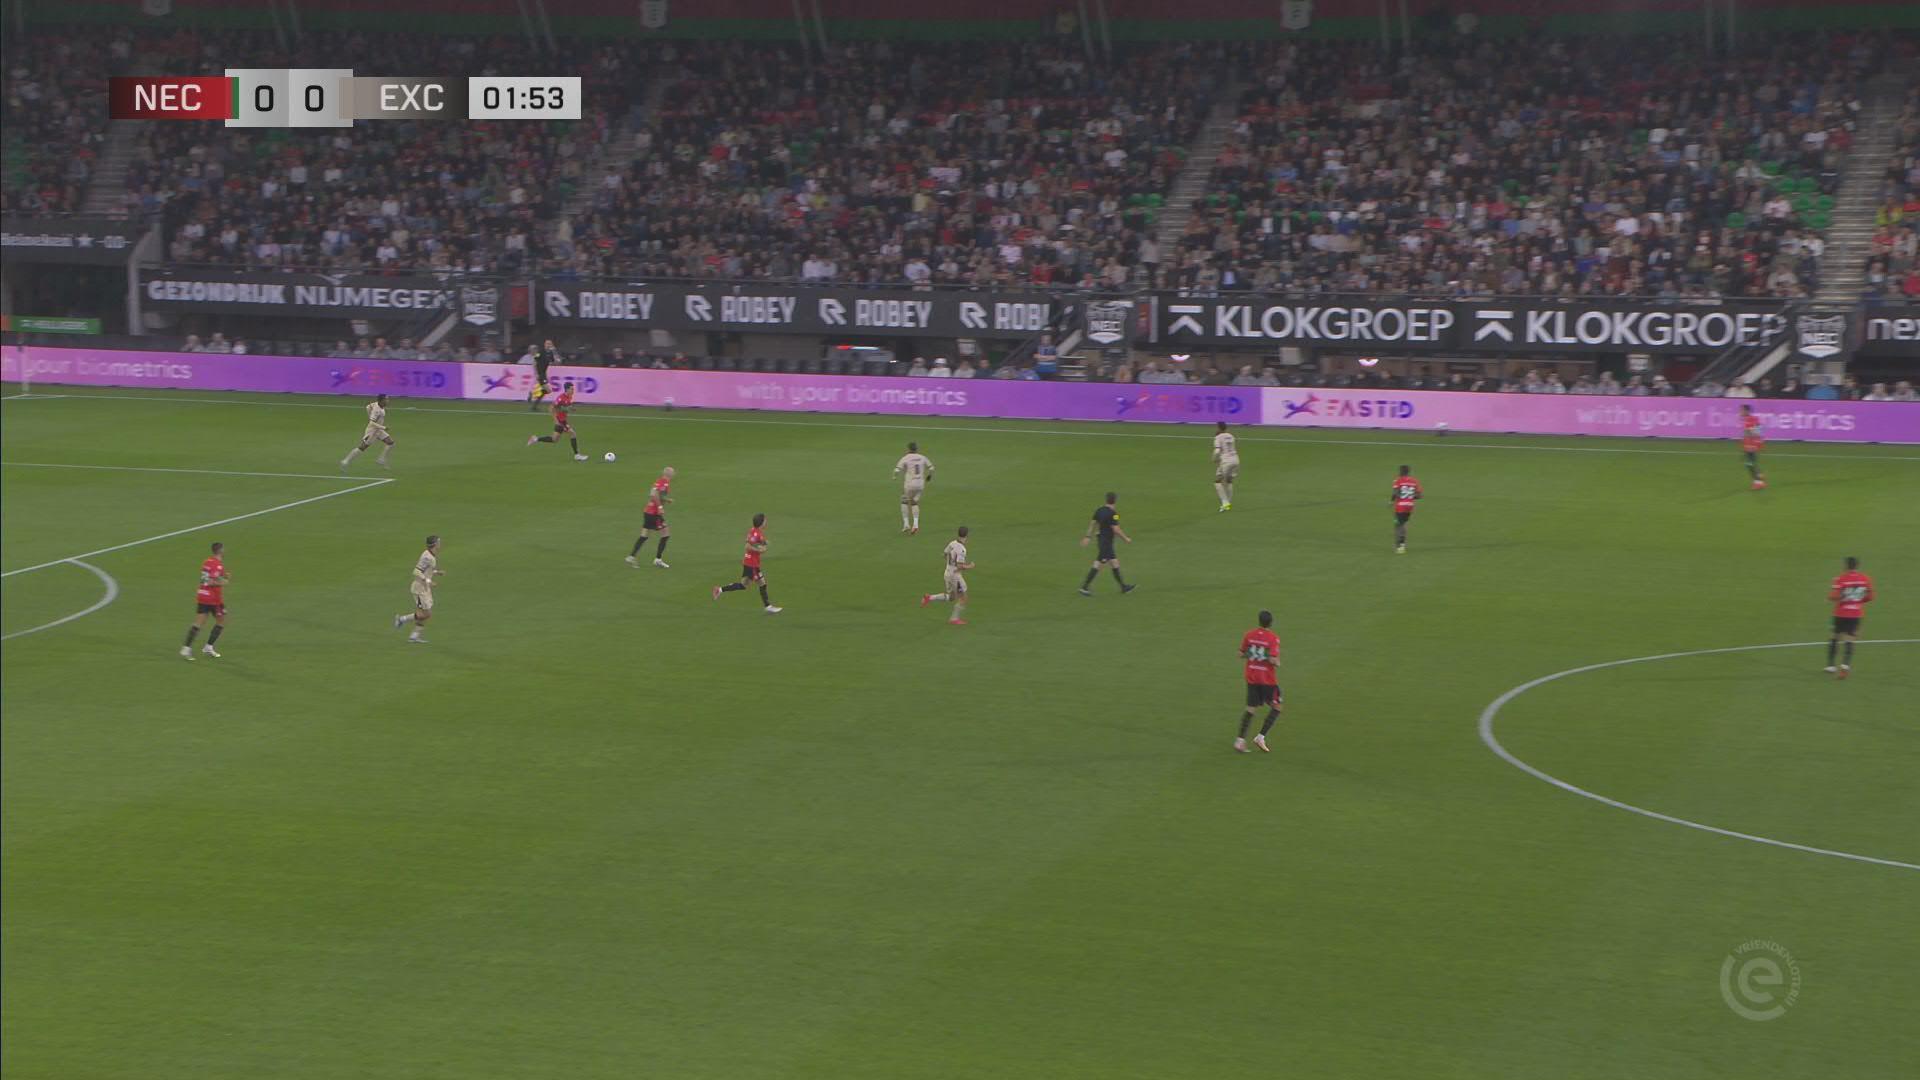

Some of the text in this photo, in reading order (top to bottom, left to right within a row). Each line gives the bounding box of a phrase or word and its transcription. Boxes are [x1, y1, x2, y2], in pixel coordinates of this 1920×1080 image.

[149, 280, 287, 304] GEZONDRIJK
[578, 291, 654, 320] ROBEY
[721, 296, 796, 324] ROBEY
[855, 299, 932, 328] ROBEY
[1215, 305, 1454, 341] KLOKGROEP
[1526, 310, 1787, 347] KLOKGROEP
[76, 356, 193, 379] biometrics
[736, 381, 966, 406] with your biometrics
[1575, 404, 1632, 425] with
[1637, 408, 1701, 431] your
